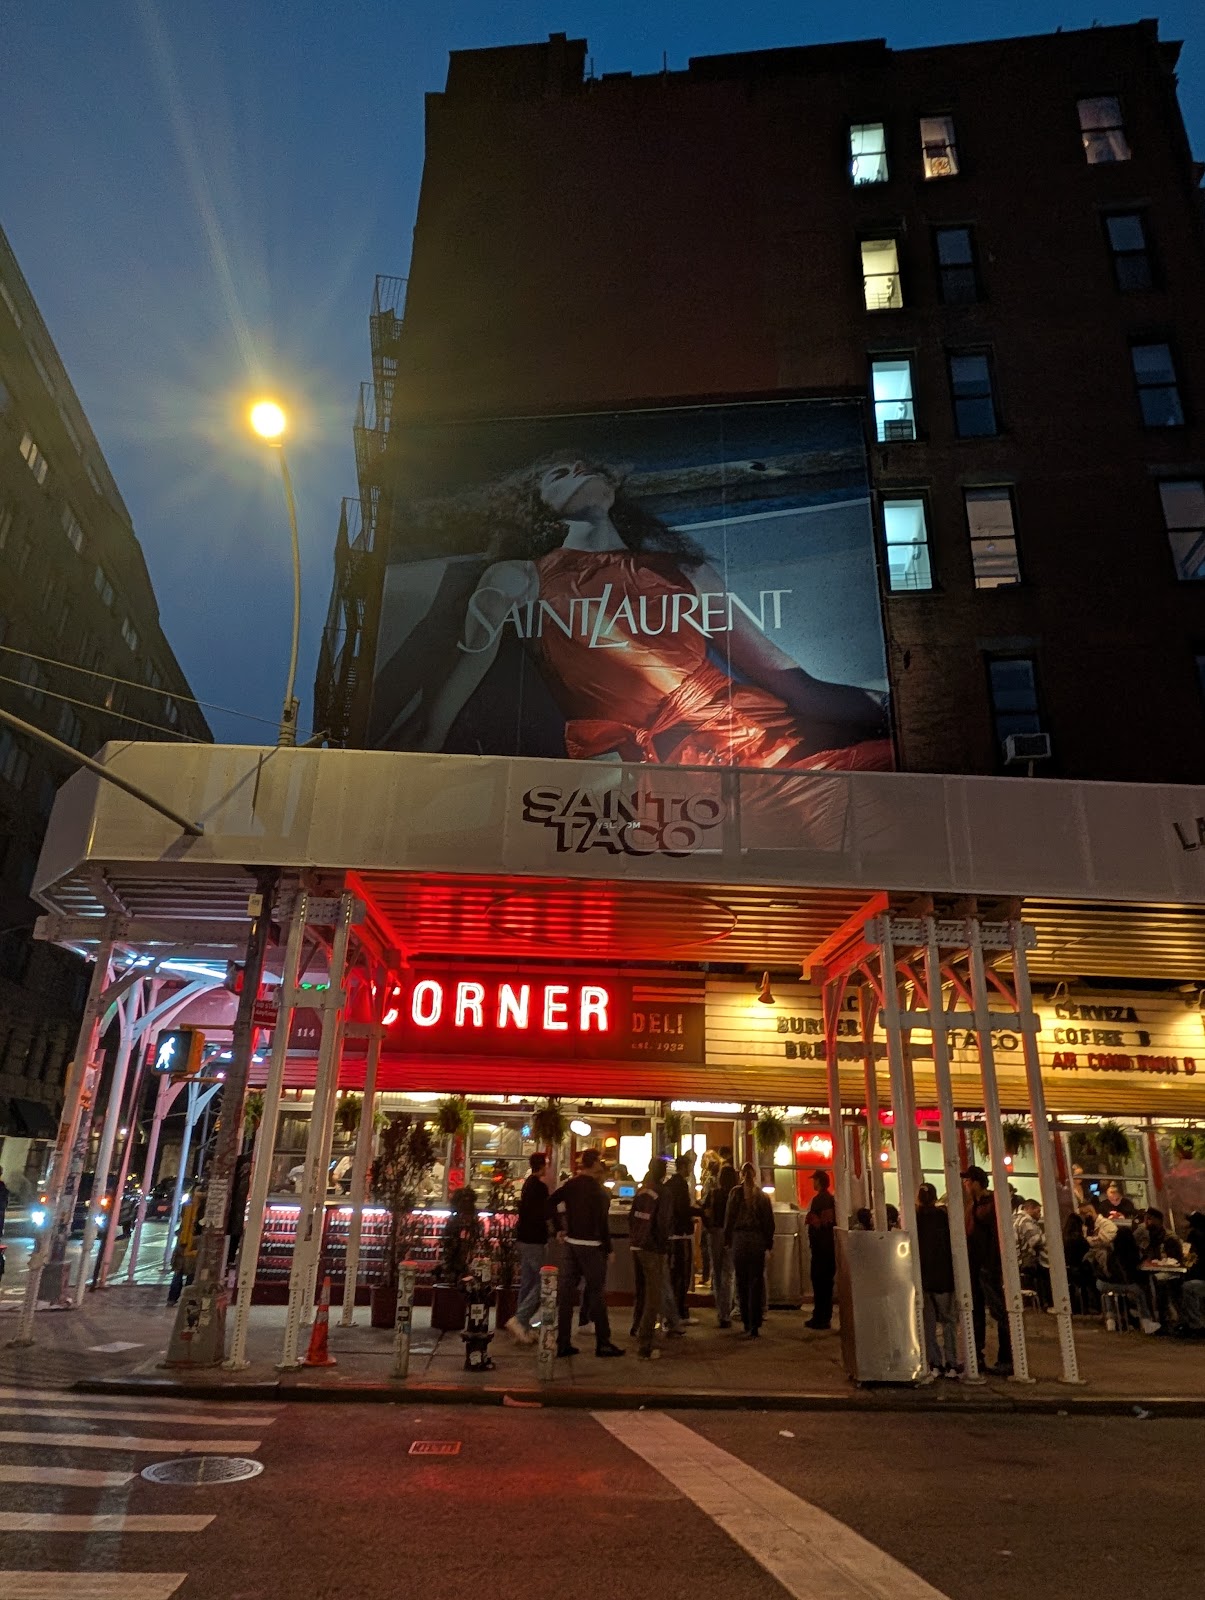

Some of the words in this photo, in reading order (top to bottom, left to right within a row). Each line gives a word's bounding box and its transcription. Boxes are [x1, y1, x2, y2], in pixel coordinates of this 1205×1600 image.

[457, 587, 602, 652] SAINT
[588, 583, 793, 648] LAURENT
[522, 785, 728, 829] SANTO
[544, 815, 705, 857] TACO
[297, 1027, 315, 1037] 114
[631, 1012, 684, 1034] DELI
[656, 1042, 684, 1052] 1932
